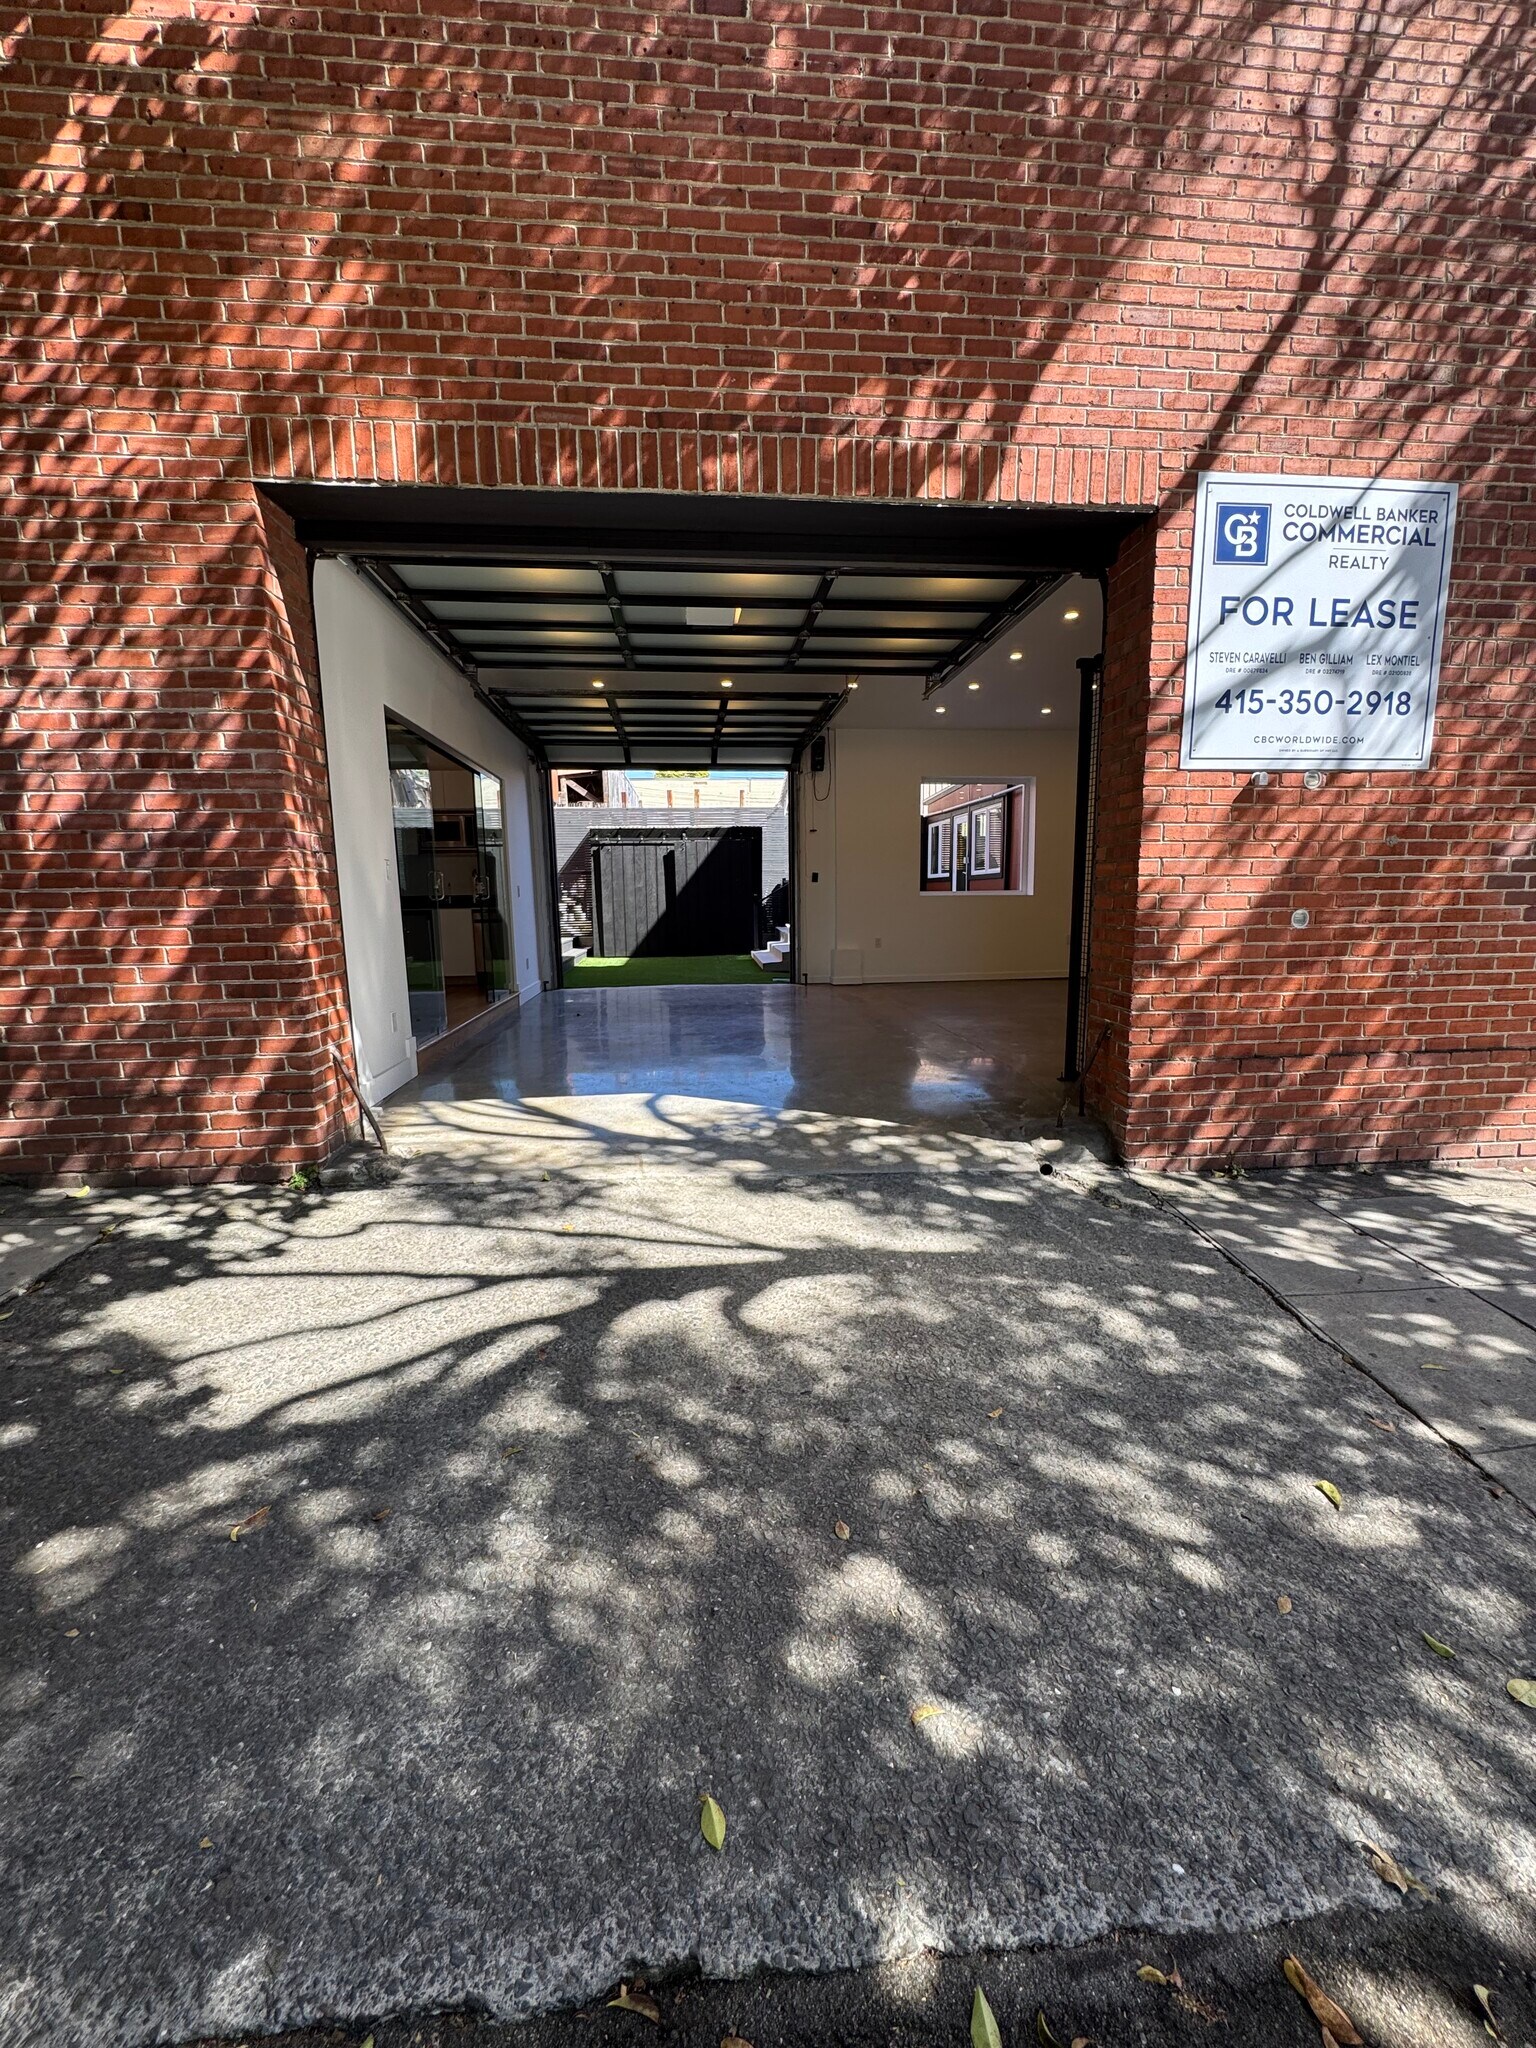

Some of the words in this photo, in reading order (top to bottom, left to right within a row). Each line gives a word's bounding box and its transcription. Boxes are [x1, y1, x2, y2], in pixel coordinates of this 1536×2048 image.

[1284, 503, 1371, 521] COLDWELL
[1377, 508, 1438, 524] BANKER
[1224, 513, 1258, 557] CB
[1282, 521, 1437, 547] COMMERCIAL
[1329, 555, 1389, 570] REALTY
[1219, 596, 1294, 626] FOR
[1309, 597, 1420, 630] LEASE
[1209, 651, 1241, 663] STEVEN
[1243, 652, 1287, 664] CARAVELLI
[1299, 653, 1317, 665] BEN
[1319, 653, 1354, 665] GILLIAM
[1366, 654, 1382, 666] LEX
[1384, 655, 1420, 666] MONTIEL
[1215, 689, 1411, 716] 415-350-2918
[1253, 735, 1364, 744] CBCWORLDWIDE.COM
